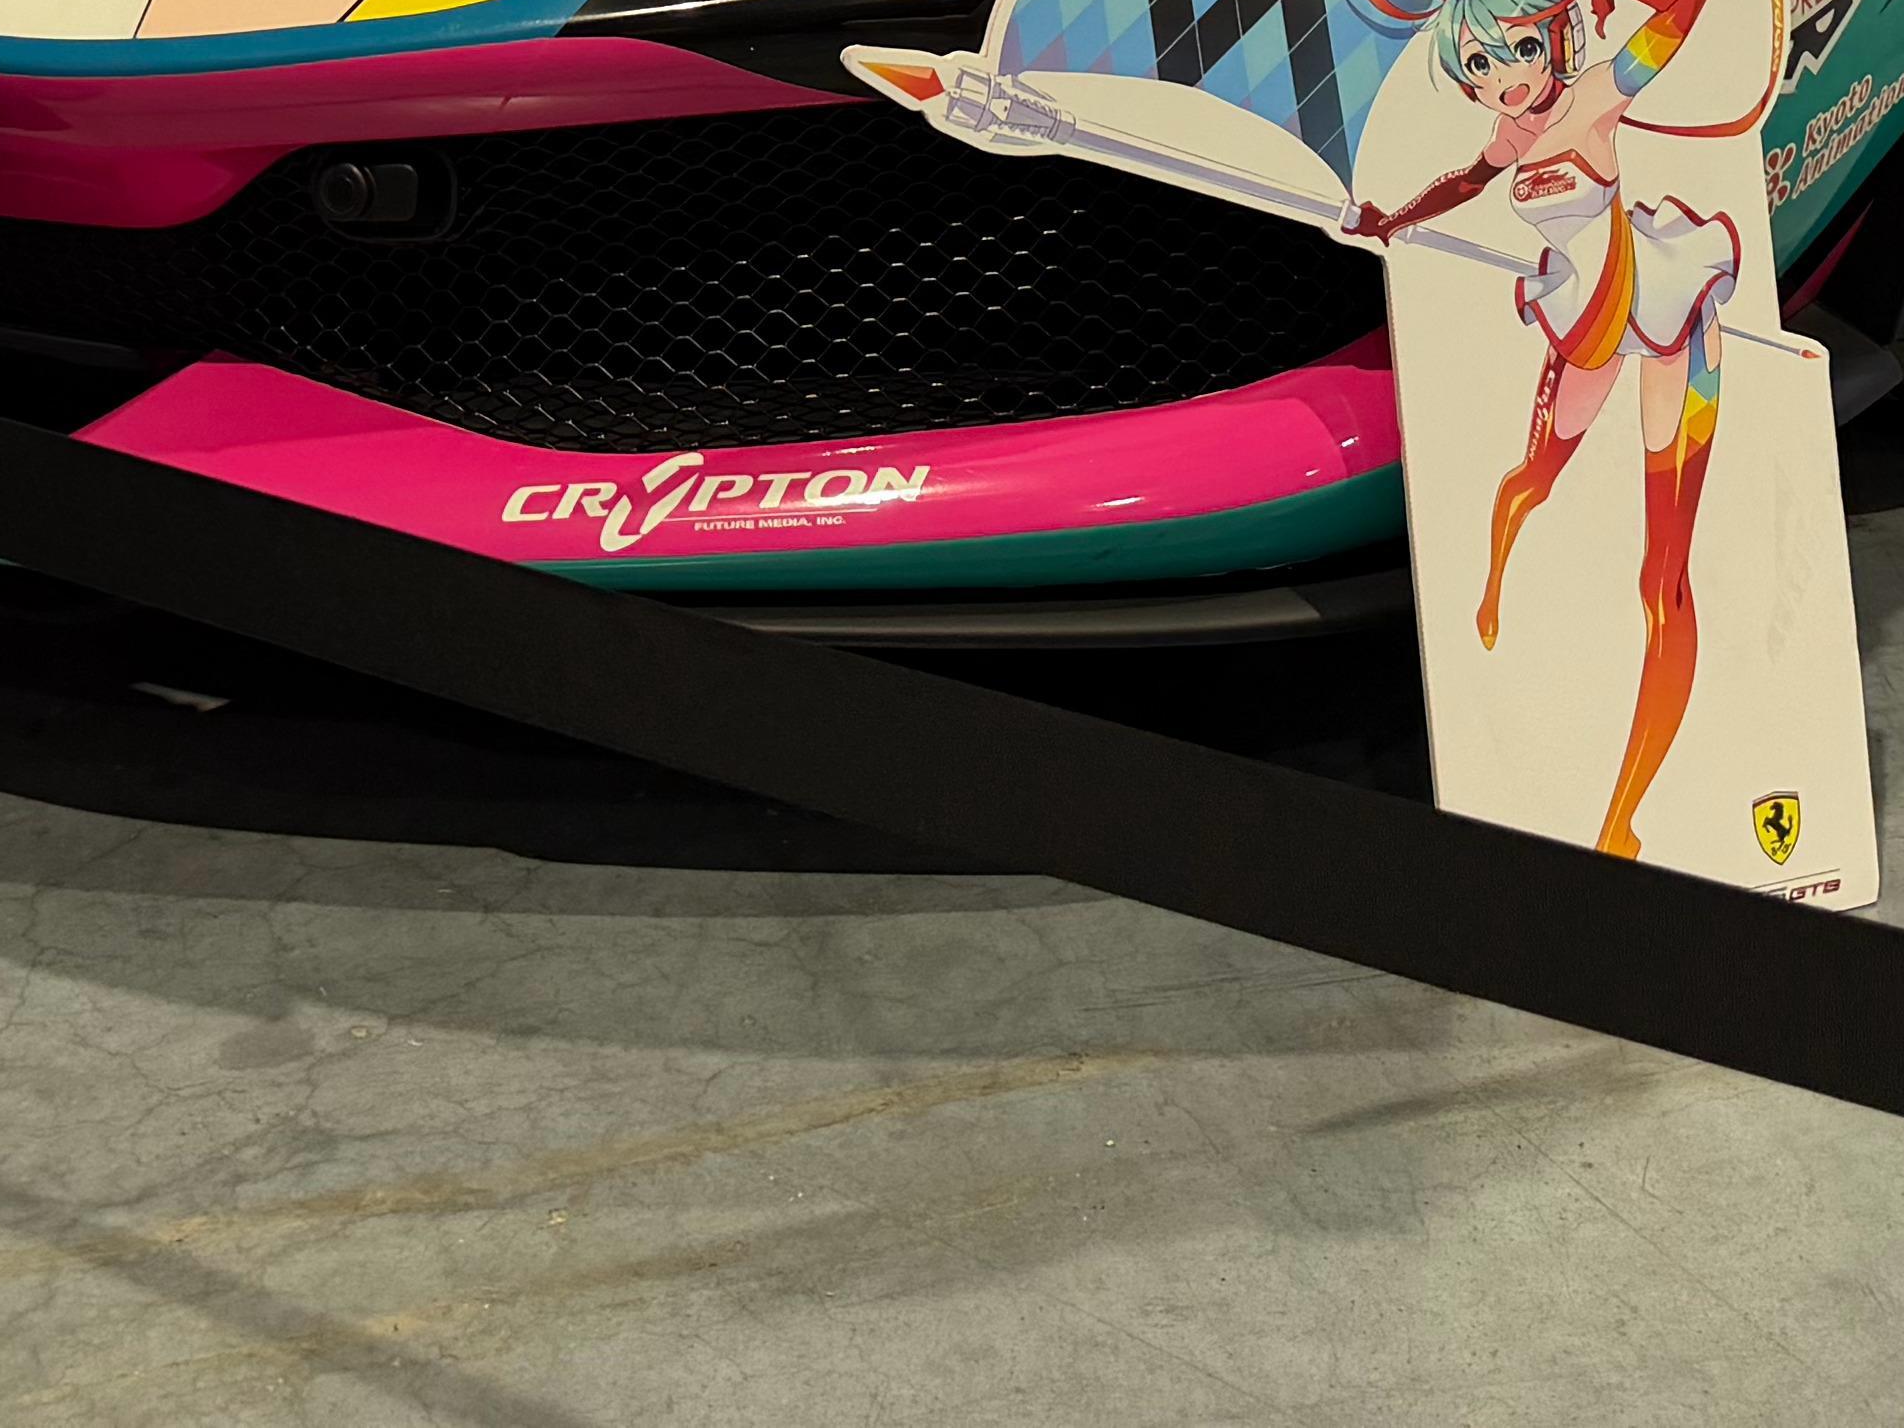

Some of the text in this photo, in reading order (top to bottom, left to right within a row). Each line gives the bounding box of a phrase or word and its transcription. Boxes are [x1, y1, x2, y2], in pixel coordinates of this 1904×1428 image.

[1802, 74, 1873, 157] Kyoto
[501, 451, 930, 553] CRYPTON
[694, 519, 756, 533] FUTURE
[816, 513, 847, 527] INC.
[1789, 878, 1841, 901] GTB
